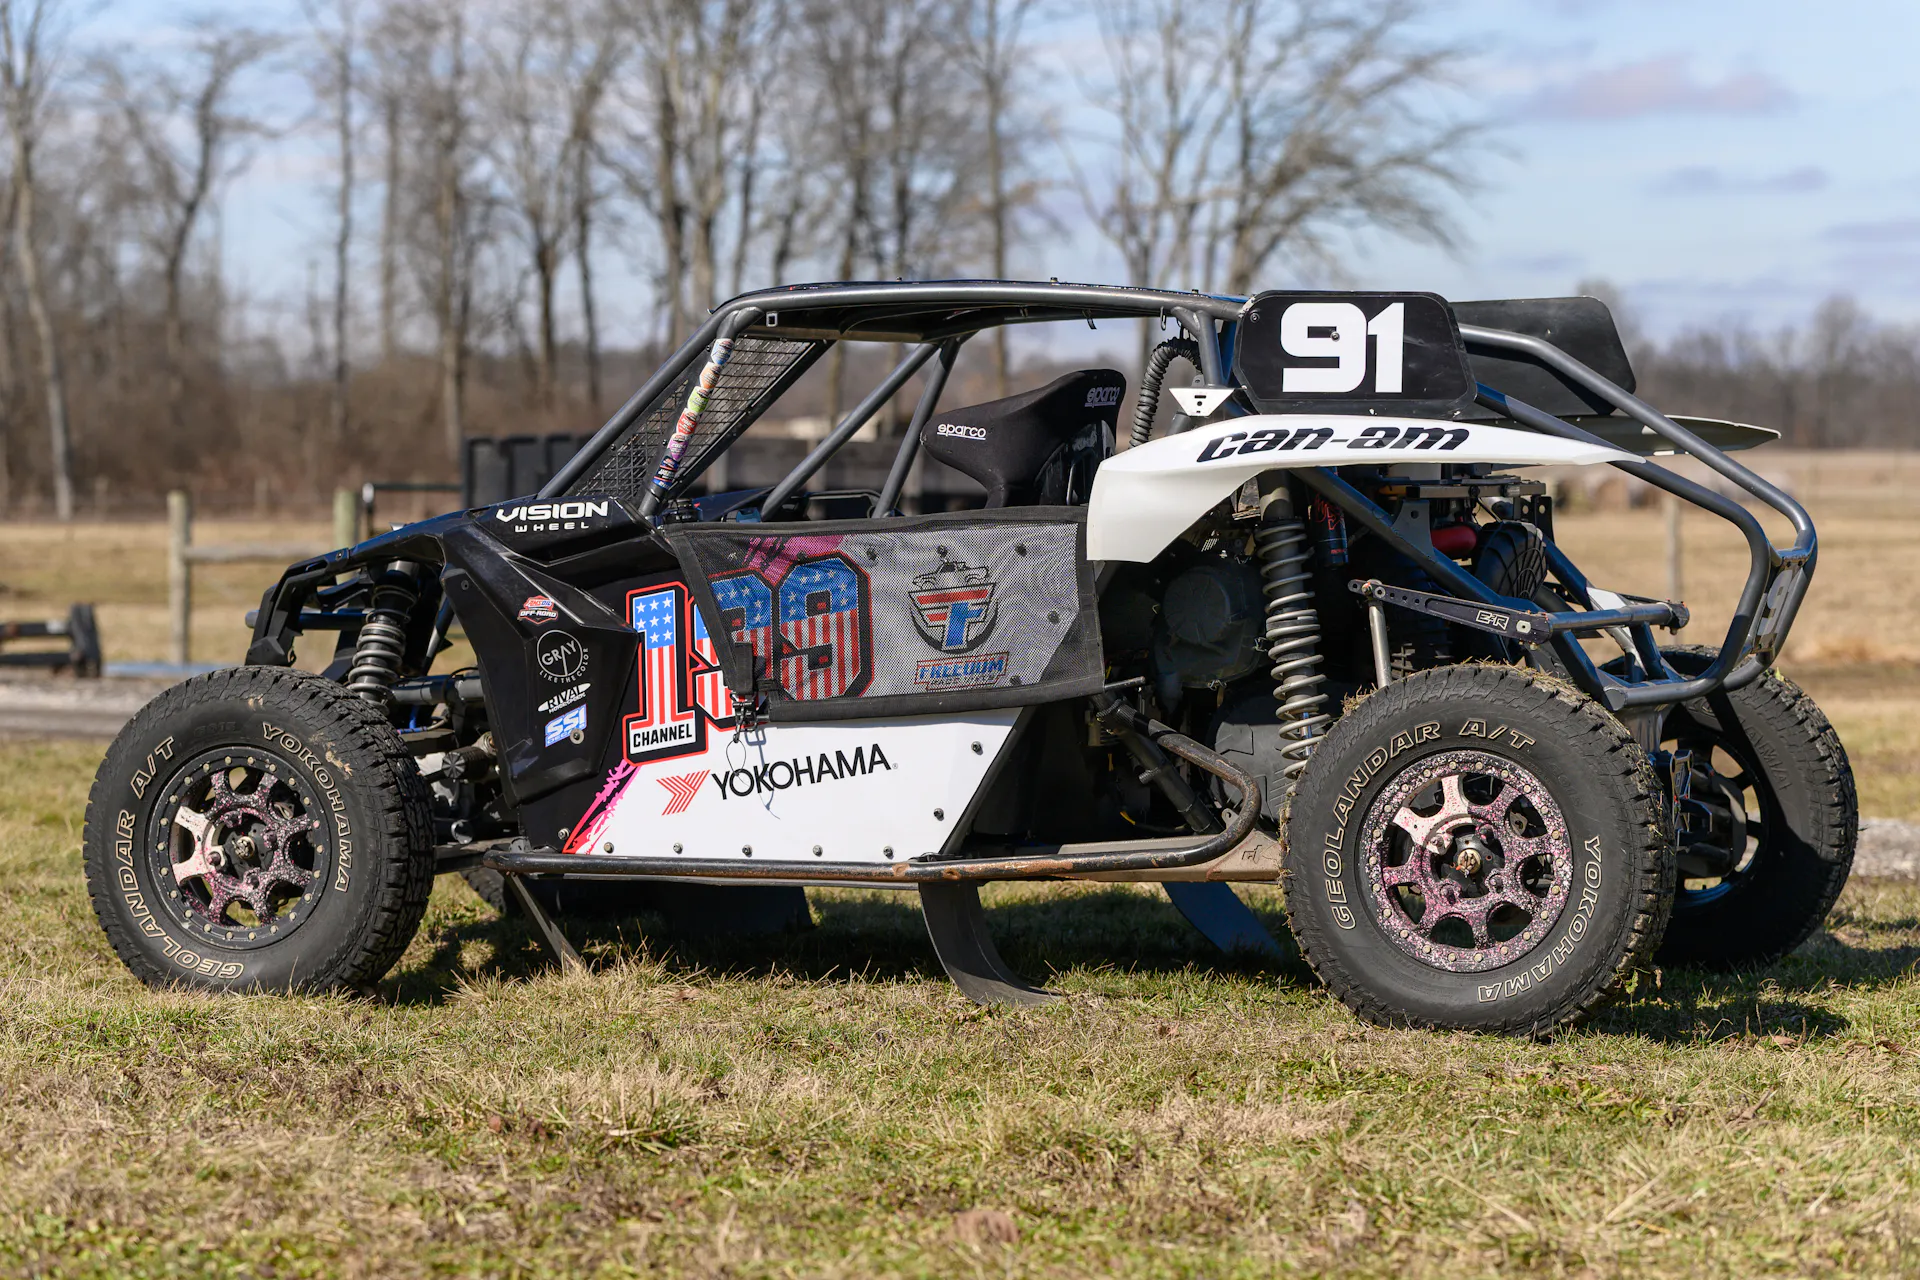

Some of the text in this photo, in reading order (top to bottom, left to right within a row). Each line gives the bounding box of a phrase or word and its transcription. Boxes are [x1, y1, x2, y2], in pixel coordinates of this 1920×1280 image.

[1281, 302, 1404, 393] 91
[1084, 386, 1121, 408] sparco
[936, 423, 986, 441] sparco
[1196, 426, 1470, 463] can-am
[495, 500, 609, 524] VISION
[514, 521, 590, 534] WHEEL
[520, 610, 556, 618] OFF-ROAD
[526, 599, 552, 608] AMSOIL
[539, 647, 589, 684] LIKE THE COLOR
[541, 640, 576, 667] GRAY
[546, 686, 583, 710] RIVAL
[547, 707, 585, 740] SSI
[633, 723, 693, 748] CHANNEL
[129, 735, 177, 800] A/T
[711, 743, 892, 800] YOKOHAMA
[262, 721, 354, 893] YOKOHAMA
[1323, 718, 1537, 932] GEOLANDAR A/T
[115, 809, 245, 980] GEOLANDAR
[1478, 835, 1604, 1004] YOKOHAMA
